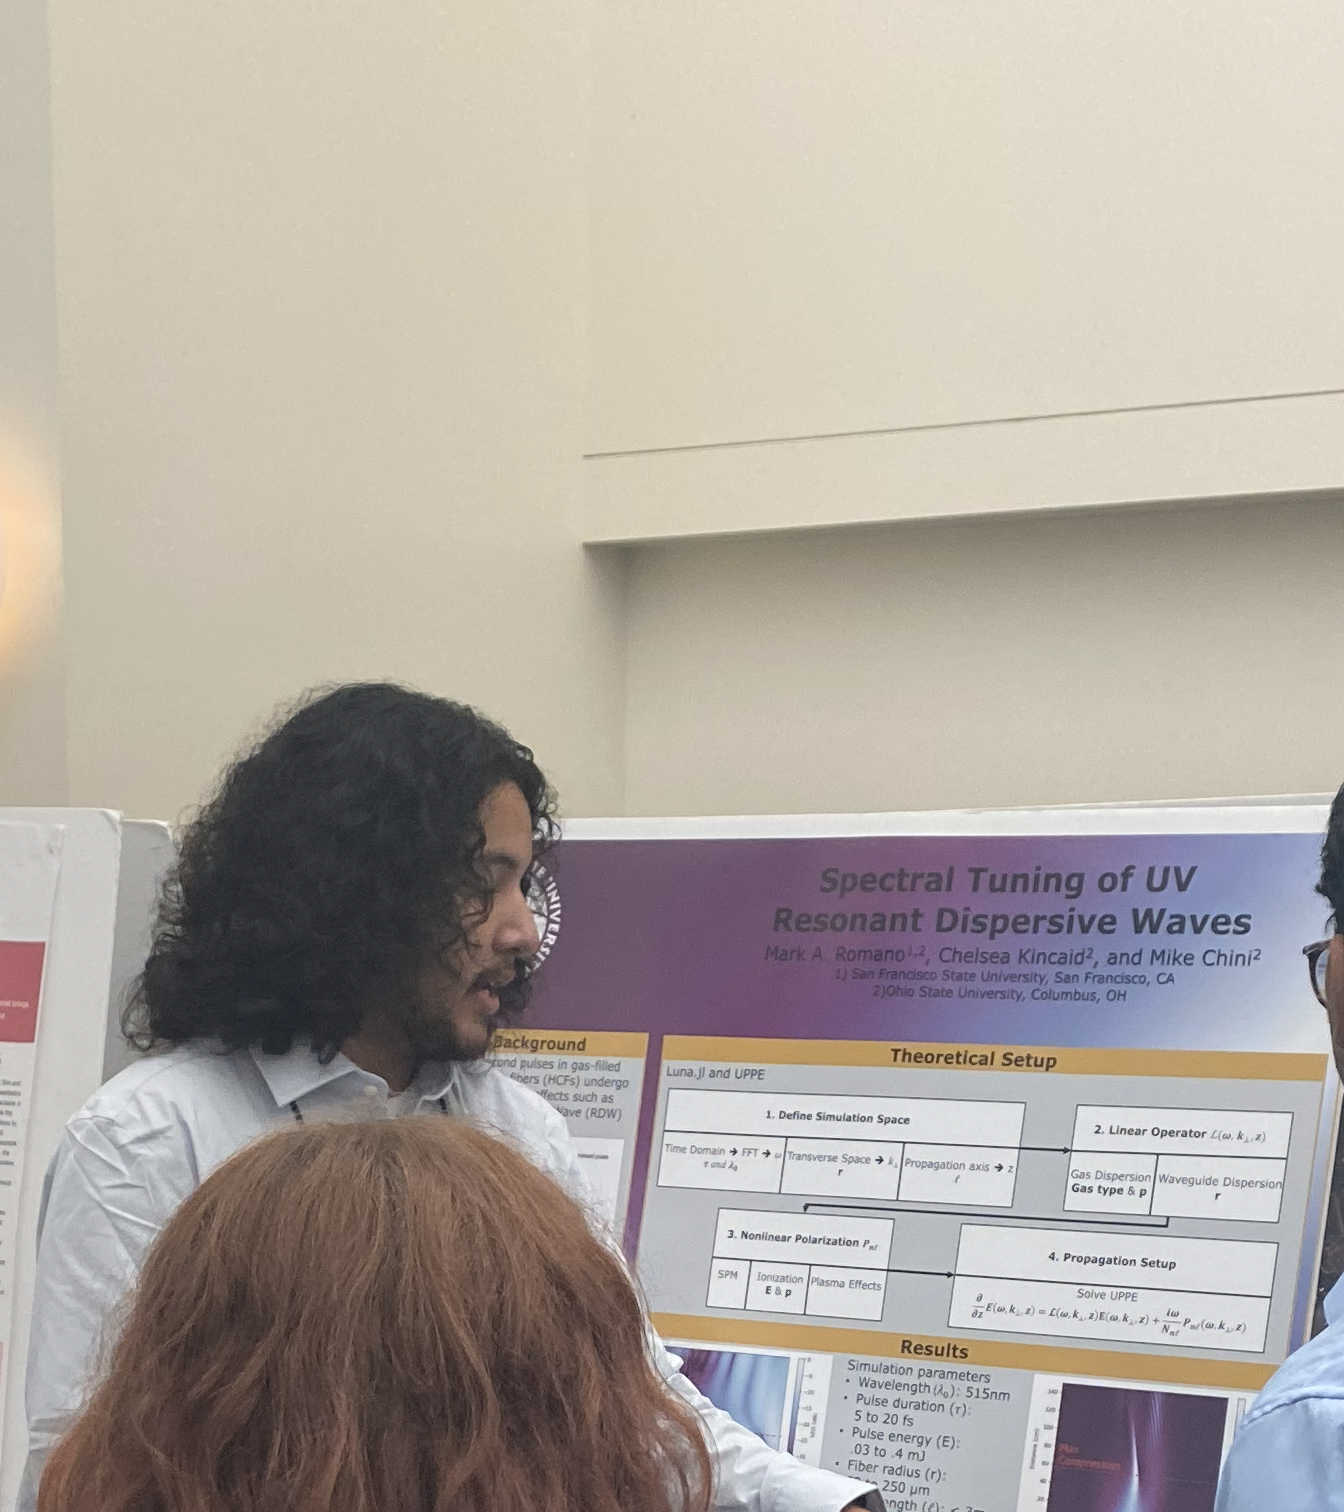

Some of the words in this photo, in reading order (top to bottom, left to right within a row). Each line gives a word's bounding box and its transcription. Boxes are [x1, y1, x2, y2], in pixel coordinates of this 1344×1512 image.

[819, 865, 954, 898] Spectral
[968, 867, 1085, 899] Tuning
[1098, 865, 1136, 892] of
[1146, 865, 1198, 893] UV
[773, 908, 923, 933] Resonant
[936, 908, 1117, 940] Dispersive
[1132, 908, 1252, 935] Waves
[764, 945, 806, 962] Mark
[939, 947, 1009, 965] Chelsea
[1107, 949, 1141, 965] and
[1150, 949, 1194, 966] Mike
[852, 968, 875, 980] San
[878, 969, 937, 981] Francisco
[942, 970, 977, 982] State
[981, 970, 1048, 985] University,
[1055, 971, 1079, 984] San
[1084, 972, 1151, 986] Francisco,
[1156, 973, 1175, 985] CA
[919, 986, 953, 998] State
[957, 987, 1025, 1002] University,
[1031, 988, 1100, 1003] Columbus,
[1107, 989, 1127, 1001] OH
[494, 1035, 587, 1052] Background
[520, 1059, 554, 1070] pulses
[558, 1060, 567, 1069] in
[571, 1060, 620, 1073] gas-filled
[891, 1049, 994, 1066] Theoretical
[1000, 1050, 1058, 1071] Setup
[708, 1068, 730, 1079] and
[735, 1069, 765, 1080] UPPE
[584, 1077, 629, 1090] undergo
[573, 1092, 597, 1103] such
[601, 1093, 613, 1103] as
[586, 1107, 622, 1120] (RDW)
[779, 1111, 812, 1121] Define
[816, 1112, 873, 1123] Simulation
[877, 1115, 910, 1126] Space
[1109, 1126, 1147, 1136] Linear
[1151, 1127, 1207, 1139] Operator
[788, 1151, 838, 1163] Transverse
[842, 1154, 870, 1166] Space
[905, 1158, 965, 1172] Propagation
[968, 1162, 990, 1171] axis
[741, 1230, 792, 1242] Nonlinear
[795, 1234, 859, 1247] Polarization
[1063, 1253, 1137, 1267] Propagation
[1140, 1257, 1176, 1271] Setup
[811, 1276, 845, 1288] Plasma
[848, 1279, 882, 1291] Effects
[900, 1340, 969, 1358] Results
[848, 1360, 913, 1376] Simulation
[918, 1365, 990, 1383] parameters
[858, 1376, 931, 1395] Wavelength
[965, 1385, 1010, 1401] 515nm
[856, 1394, 888, 1408] Pulse
[892, 1397, 945, 1413] duration
[854, 1410, 861, 1422] 5
[866, 1411, 878, 1423] to
[882, 1413, 899, 1425] 20
[903, 1414, 914, 1427] fs
[852, 1427, 884, 1441] Pulse
[889, 1431, 932, 1448] energy
[848, 1460, 879, 1473] Fiber
[883, 1462, 921, 1479] radius
[882, 1481, 906, 1494] 250
